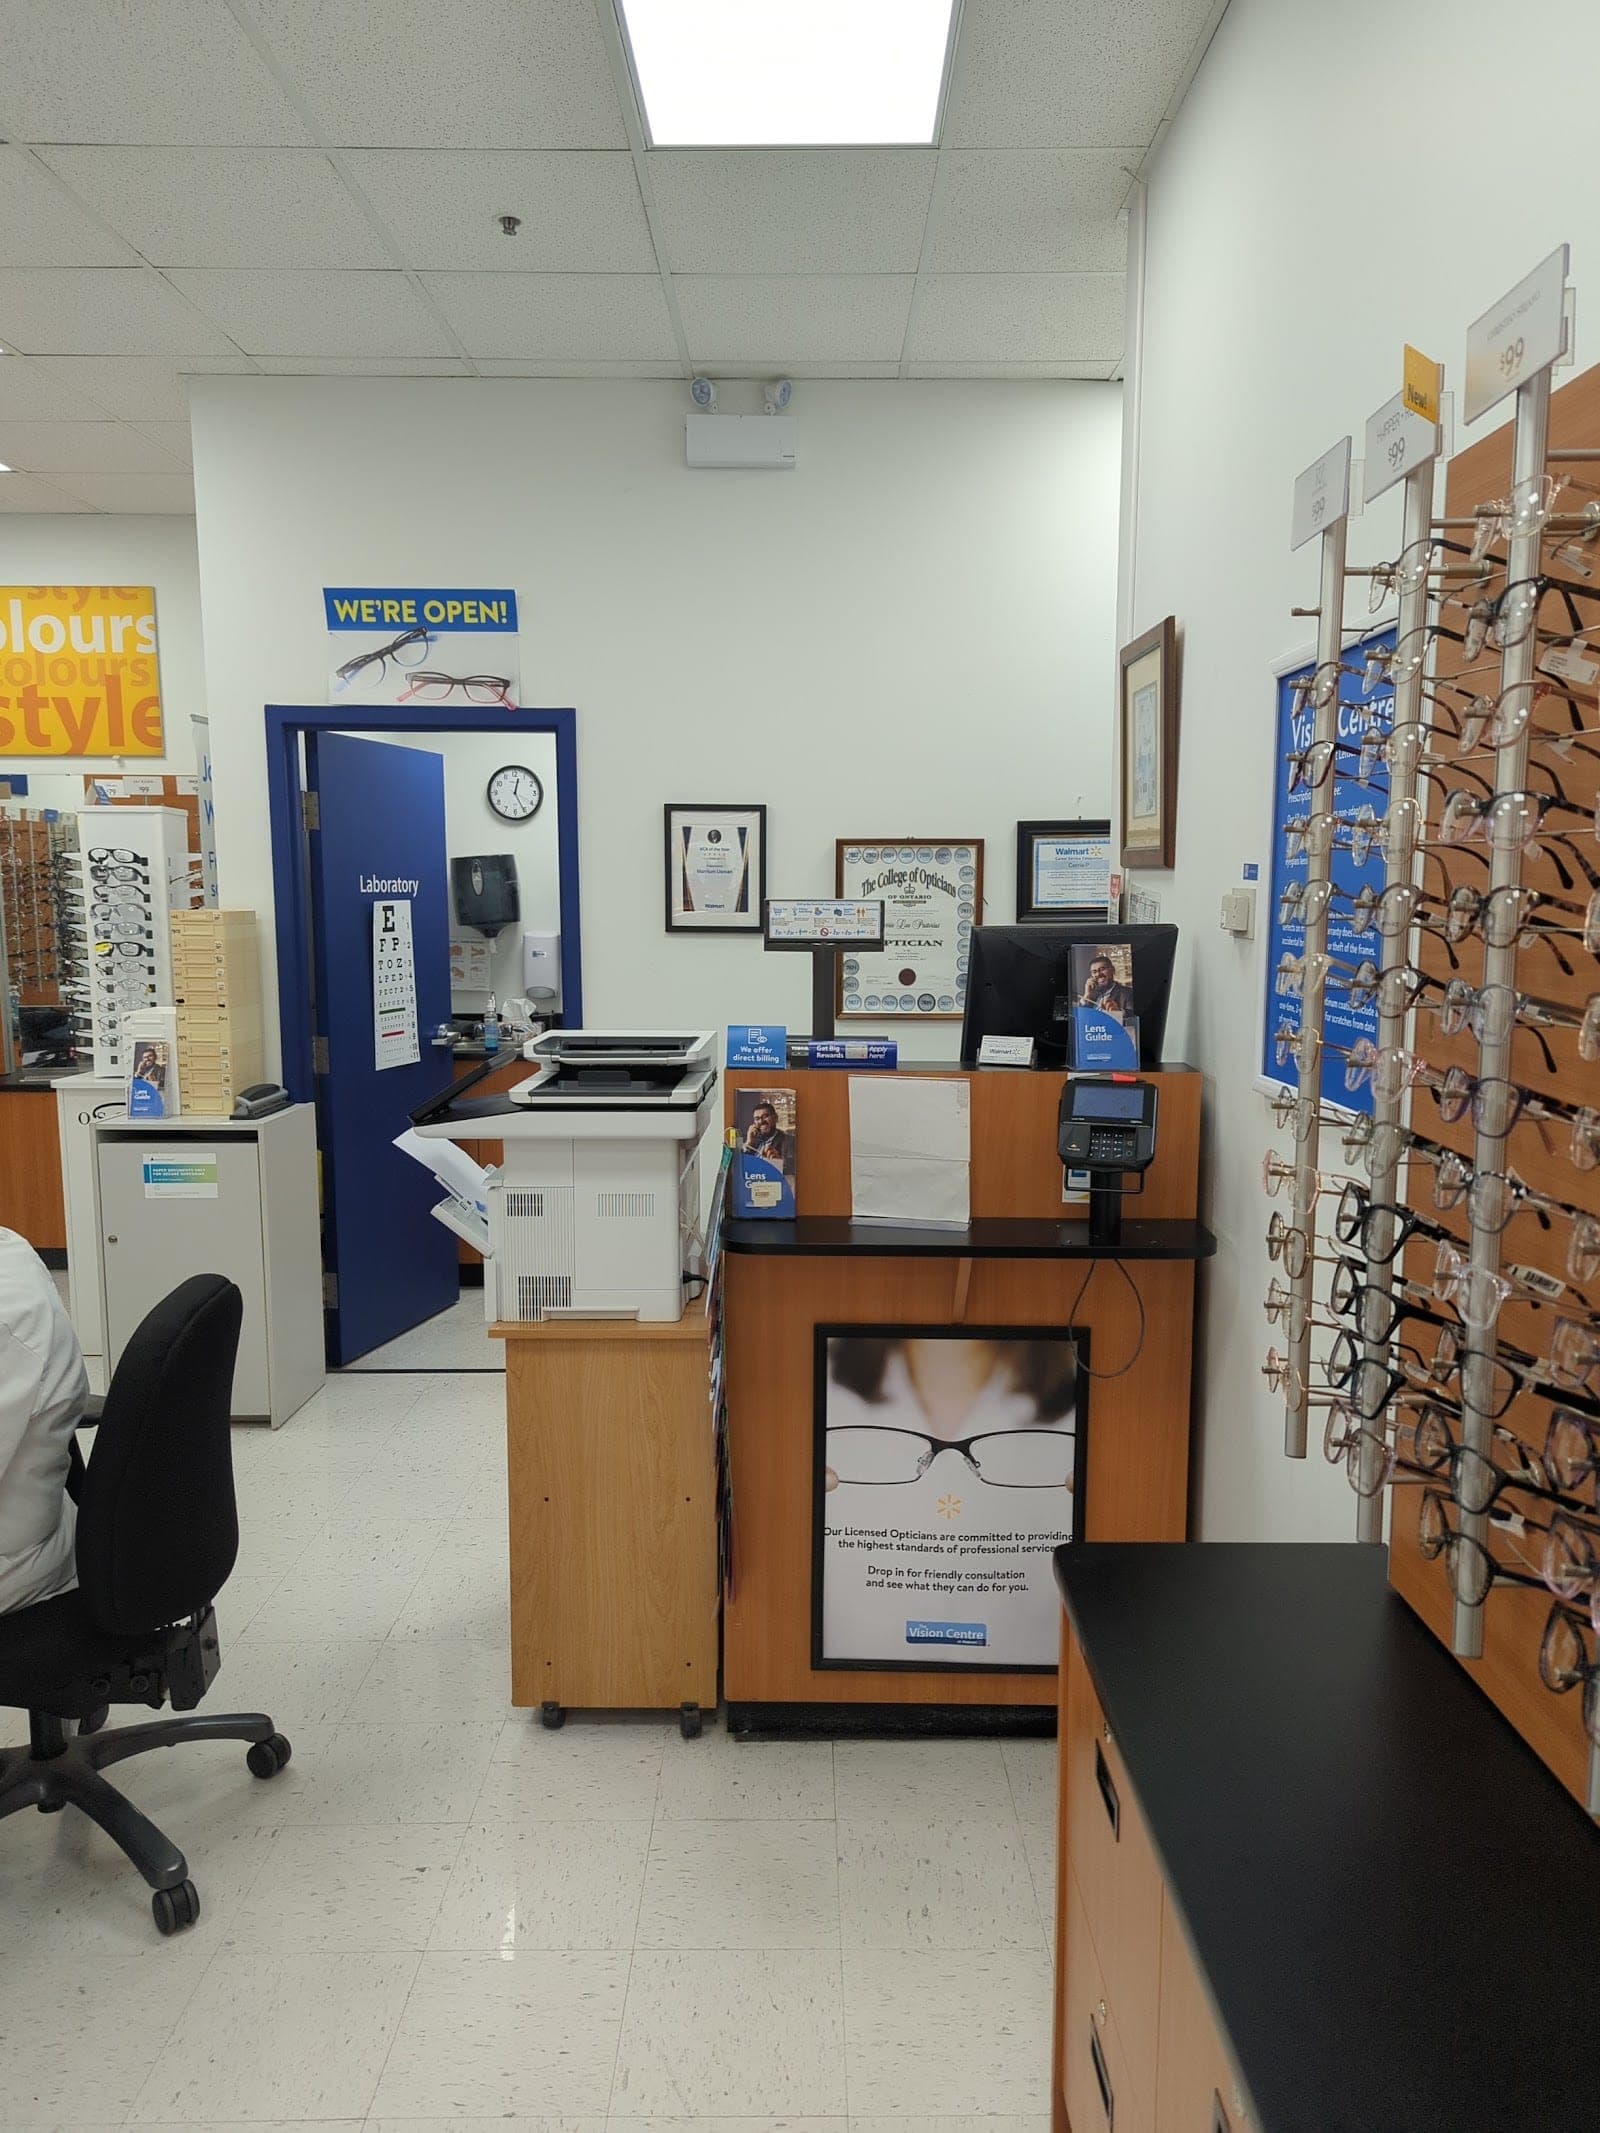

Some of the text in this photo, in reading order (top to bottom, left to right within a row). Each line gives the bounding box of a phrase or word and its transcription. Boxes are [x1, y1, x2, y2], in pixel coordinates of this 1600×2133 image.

[1500, 336, 1524, 376] $99
[1407, 382, 1428, 410] New!
[1387, 437, 1405, 468] $99
[333, 599, 507, 624] WE'RE OPEN!
[1055, 847, 1089, 855] Walmart
[359, 874, 419, 897] Laboratory
[862, 867, 956, 898] The College of Opticians
[382, 905, 395, 933] E
[885, 939, 944, 947] PTICIAN
[1333, 941, 1343, 952] theft
[1344, 942, 1350, 952] of
[1085, 1024, 1106, 1032] Lens
[1332, 1014, 1351, 1027] scratches
[1352, 1018, 1364, 1030] from
[1085, 1033, 1113, 1041] Guide
[733, 1054, 780, 1064] direct billing
[745, 1172, 766, 1180] Lens
[824, 1527, 843, 1537] Our
[845, 1527, 887, 1538] Licensed
[890, 1529, 937, 1543] Opticians
[940, 1534, 956, 1542] are
[958, 1531, 1012, 1542] committed
[1015, 1533, 1026, 1542] to
[838, 1539, 855, 1549] the
[857, 1540, 894, 1552] highest
[896, 1542, 944, 1554] standards
[947, 1543, 959, 1554] of
[960, 1544, 1019, 1556] professional
[867, 1566, 1025, 1582] Drop in for friendly consultation
[865, 1579, 1029, 1594] and see what they can do for you.
[909, 1627, 984, 1640] Vision Centre
